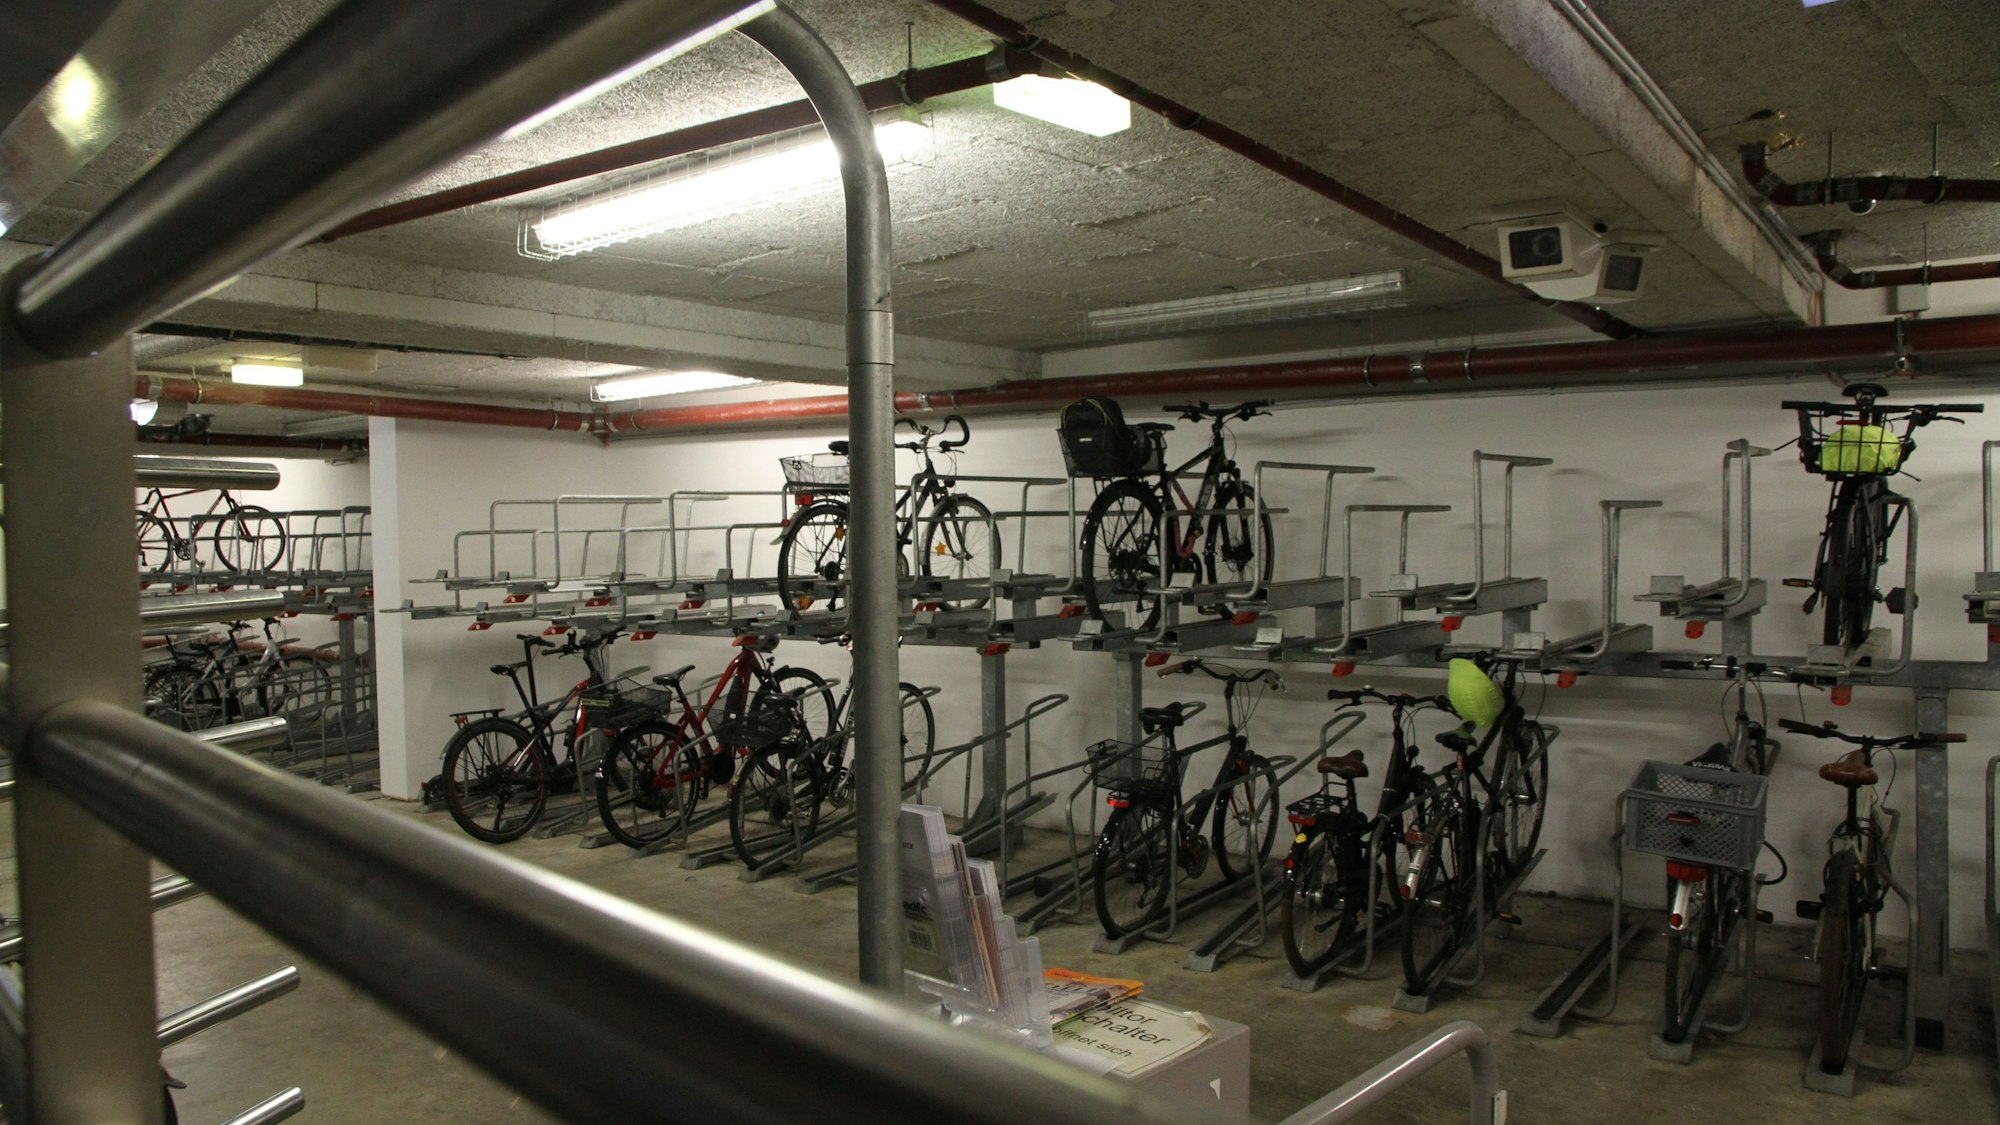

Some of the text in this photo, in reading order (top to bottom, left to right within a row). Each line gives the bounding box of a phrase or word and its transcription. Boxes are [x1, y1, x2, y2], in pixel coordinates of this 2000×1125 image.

[1097, 1004, 1158, 1024] olltor
[1077, 1014, 1171, 1045] chalter
[1097, 1043, 1133, 1057] sich
